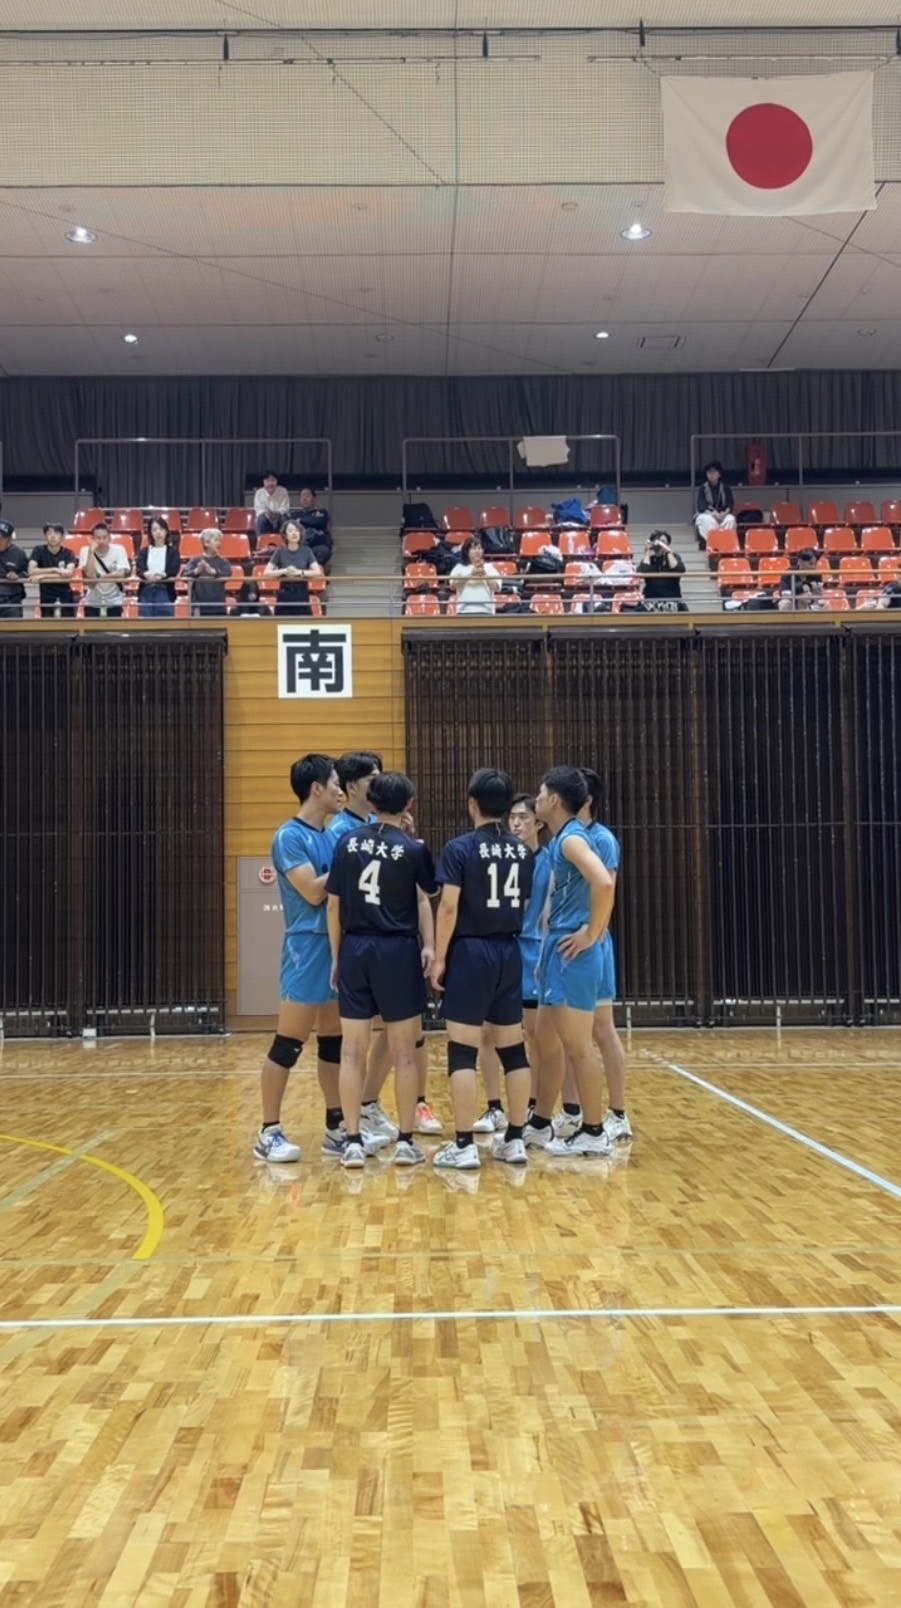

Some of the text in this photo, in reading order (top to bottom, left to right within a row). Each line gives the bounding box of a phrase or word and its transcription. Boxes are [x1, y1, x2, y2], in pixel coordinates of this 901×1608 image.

[282, 629, 346, 693] 南
[346, 837, 405, 861] 長崎大学
[478, 842, 527, 860] 長崎大学
[358, 859, 382, 906] 4
[487, 862, 520, 908] 14
